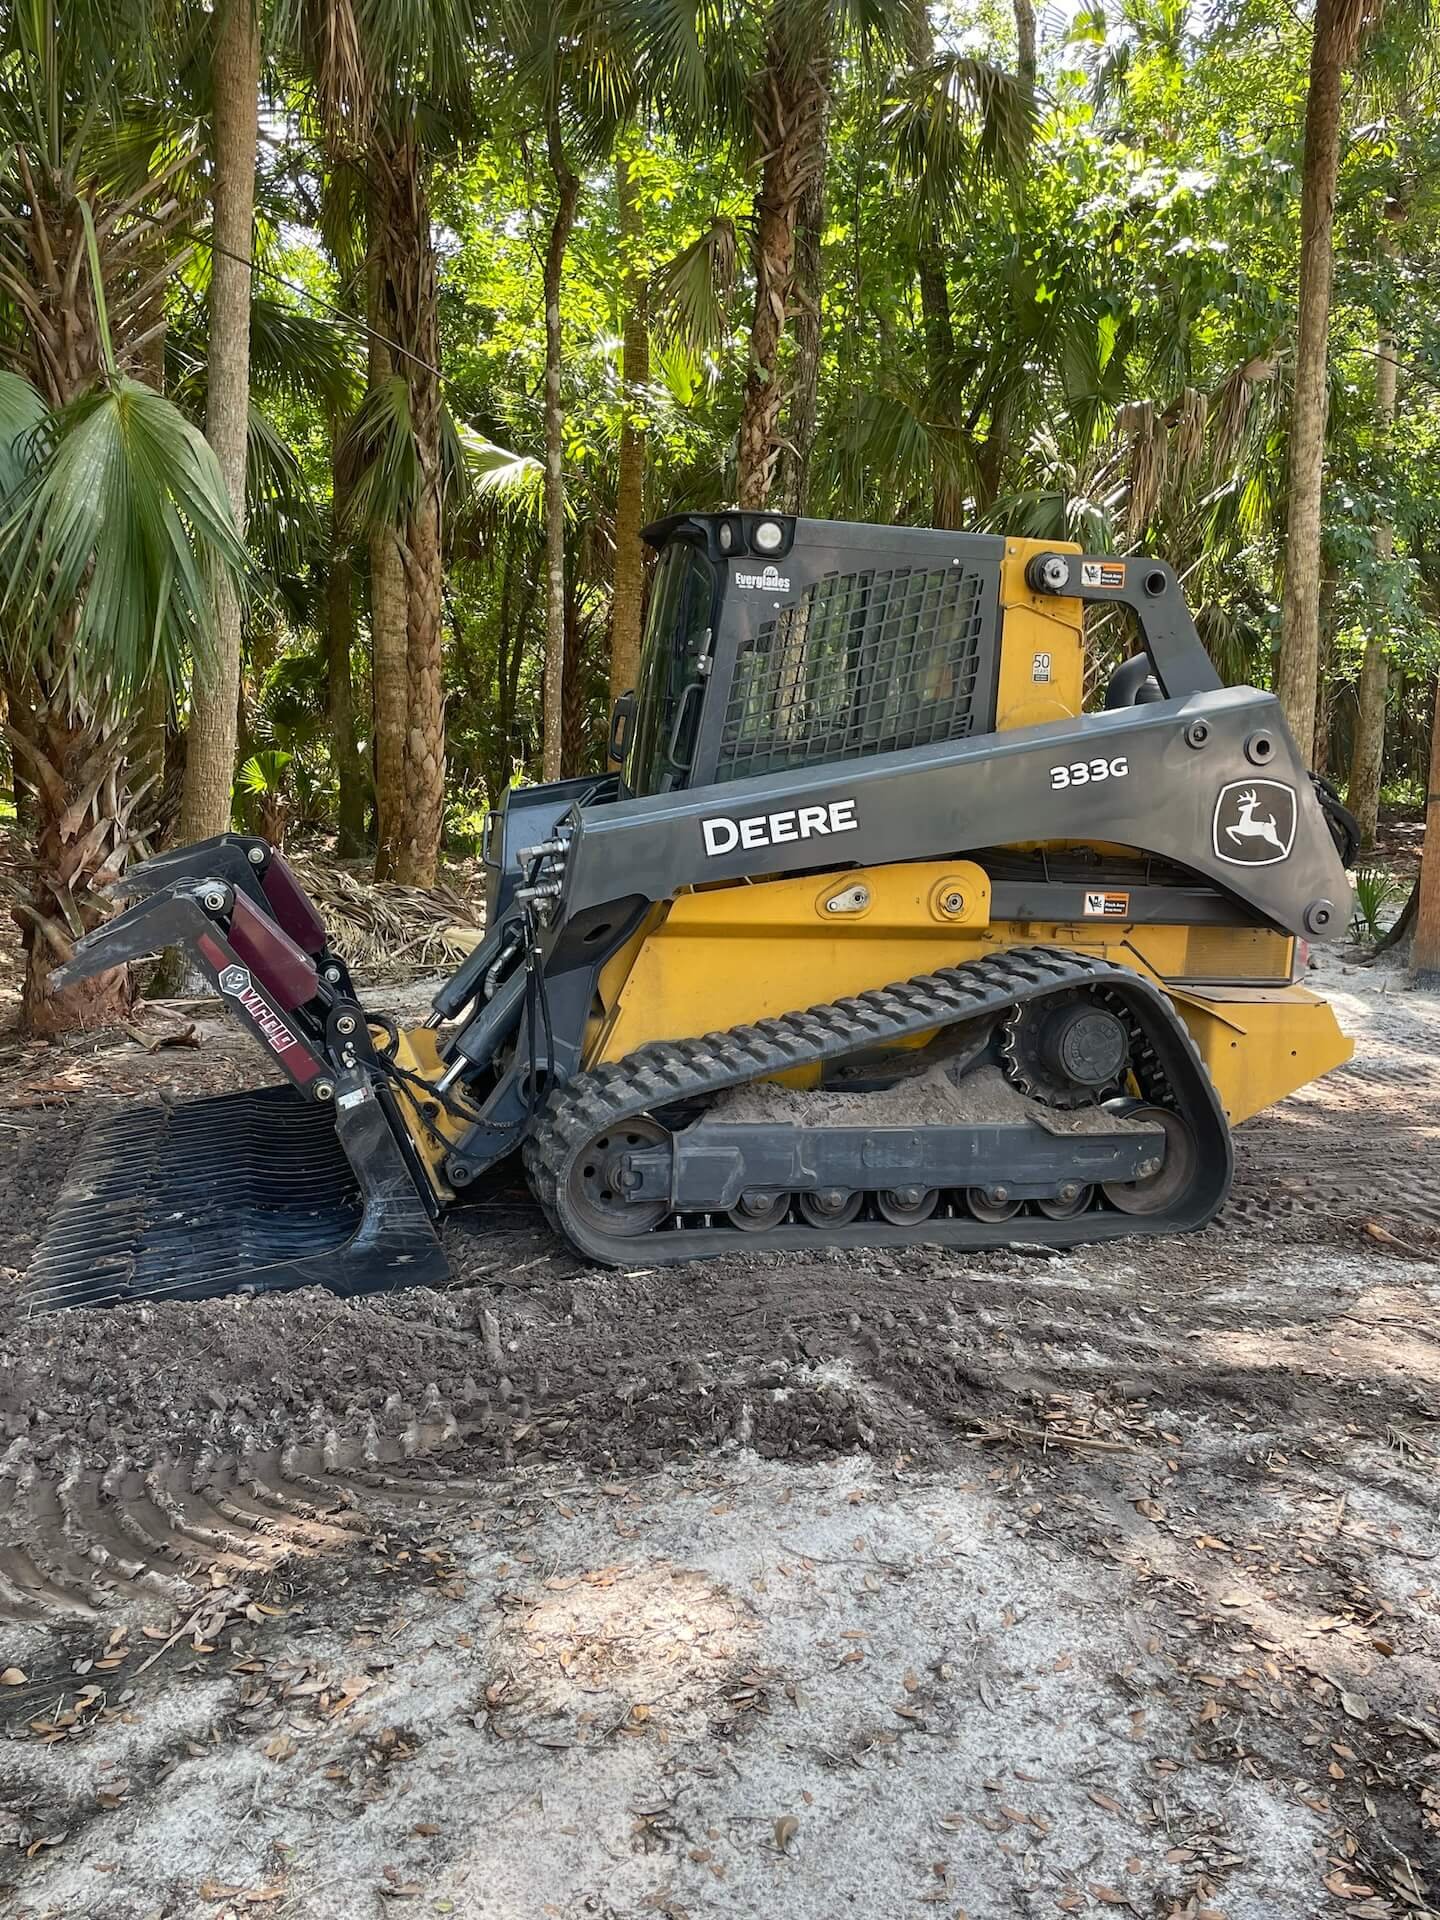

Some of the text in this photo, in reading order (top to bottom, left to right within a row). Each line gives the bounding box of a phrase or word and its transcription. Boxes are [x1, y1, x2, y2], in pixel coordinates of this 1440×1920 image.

[735, 572, 791, 589] Everglades
[1033, 654, 1050, 669] 50
[1050, 757, 1129, 790] 333G
[702, 800, 858, 856] DEERE
